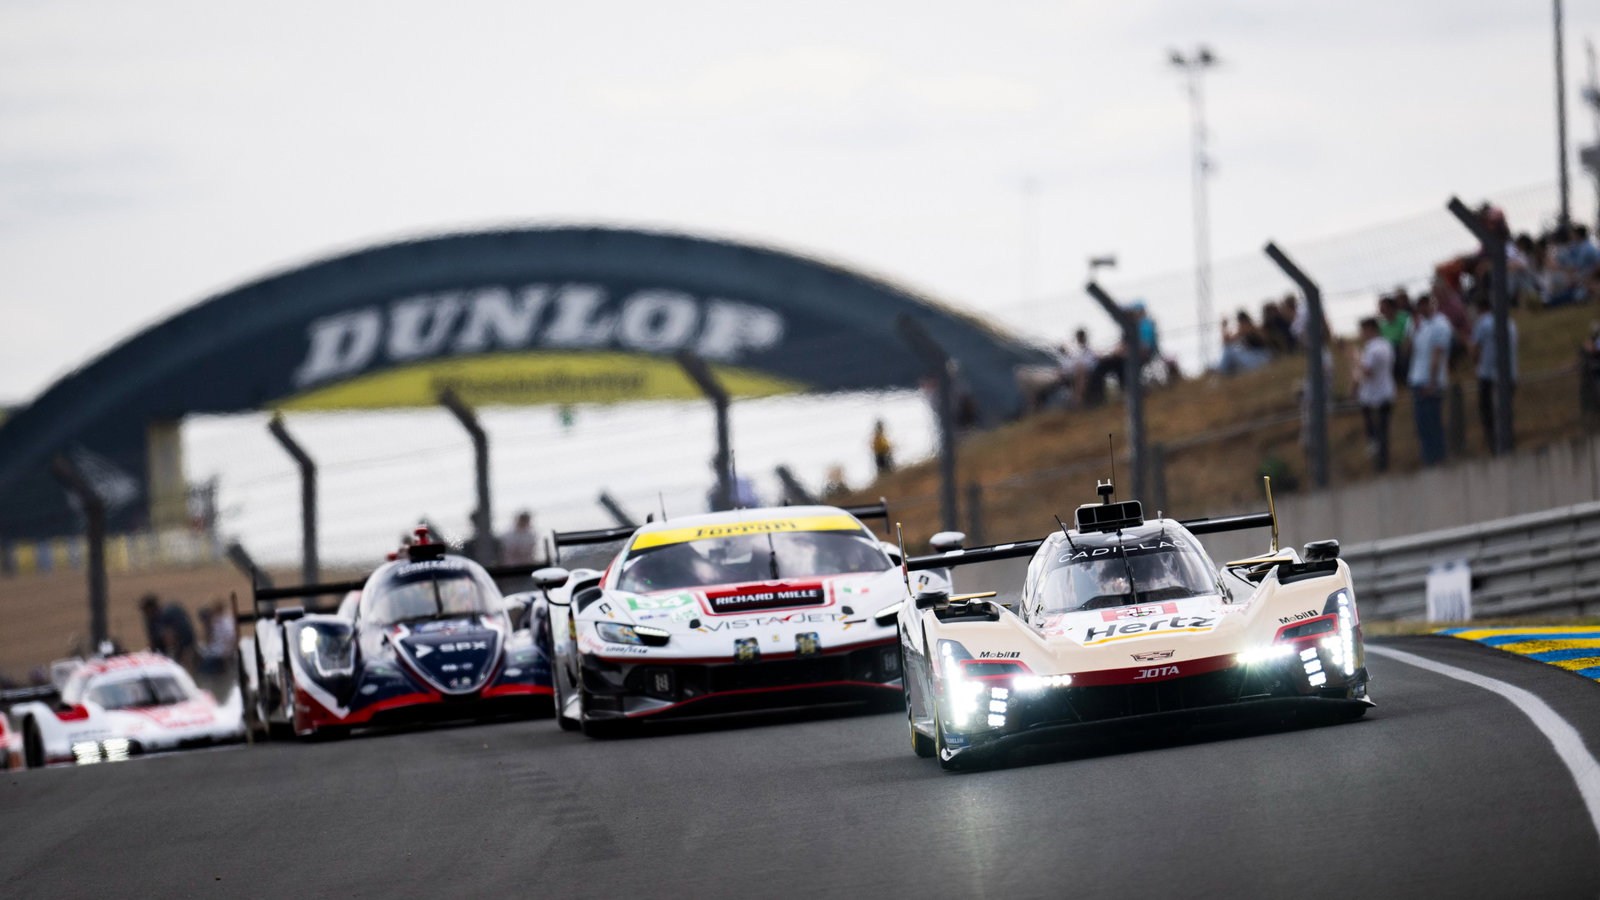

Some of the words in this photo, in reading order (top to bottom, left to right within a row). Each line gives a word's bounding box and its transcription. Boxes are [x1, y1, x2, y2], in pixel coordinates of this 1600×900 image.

[293, 283, 785, 386] DUNLOP
[695, 520, 798, 538] Ferrari
[1058, 540, 1187, 563] CADILLAC
[716, 591, 774, 606] RICHARD
[777, 589, 818, 600] MILLE
[1083, 616, 1217, 642] Hertz
[1133, 665, 1180, 680] JOTA
